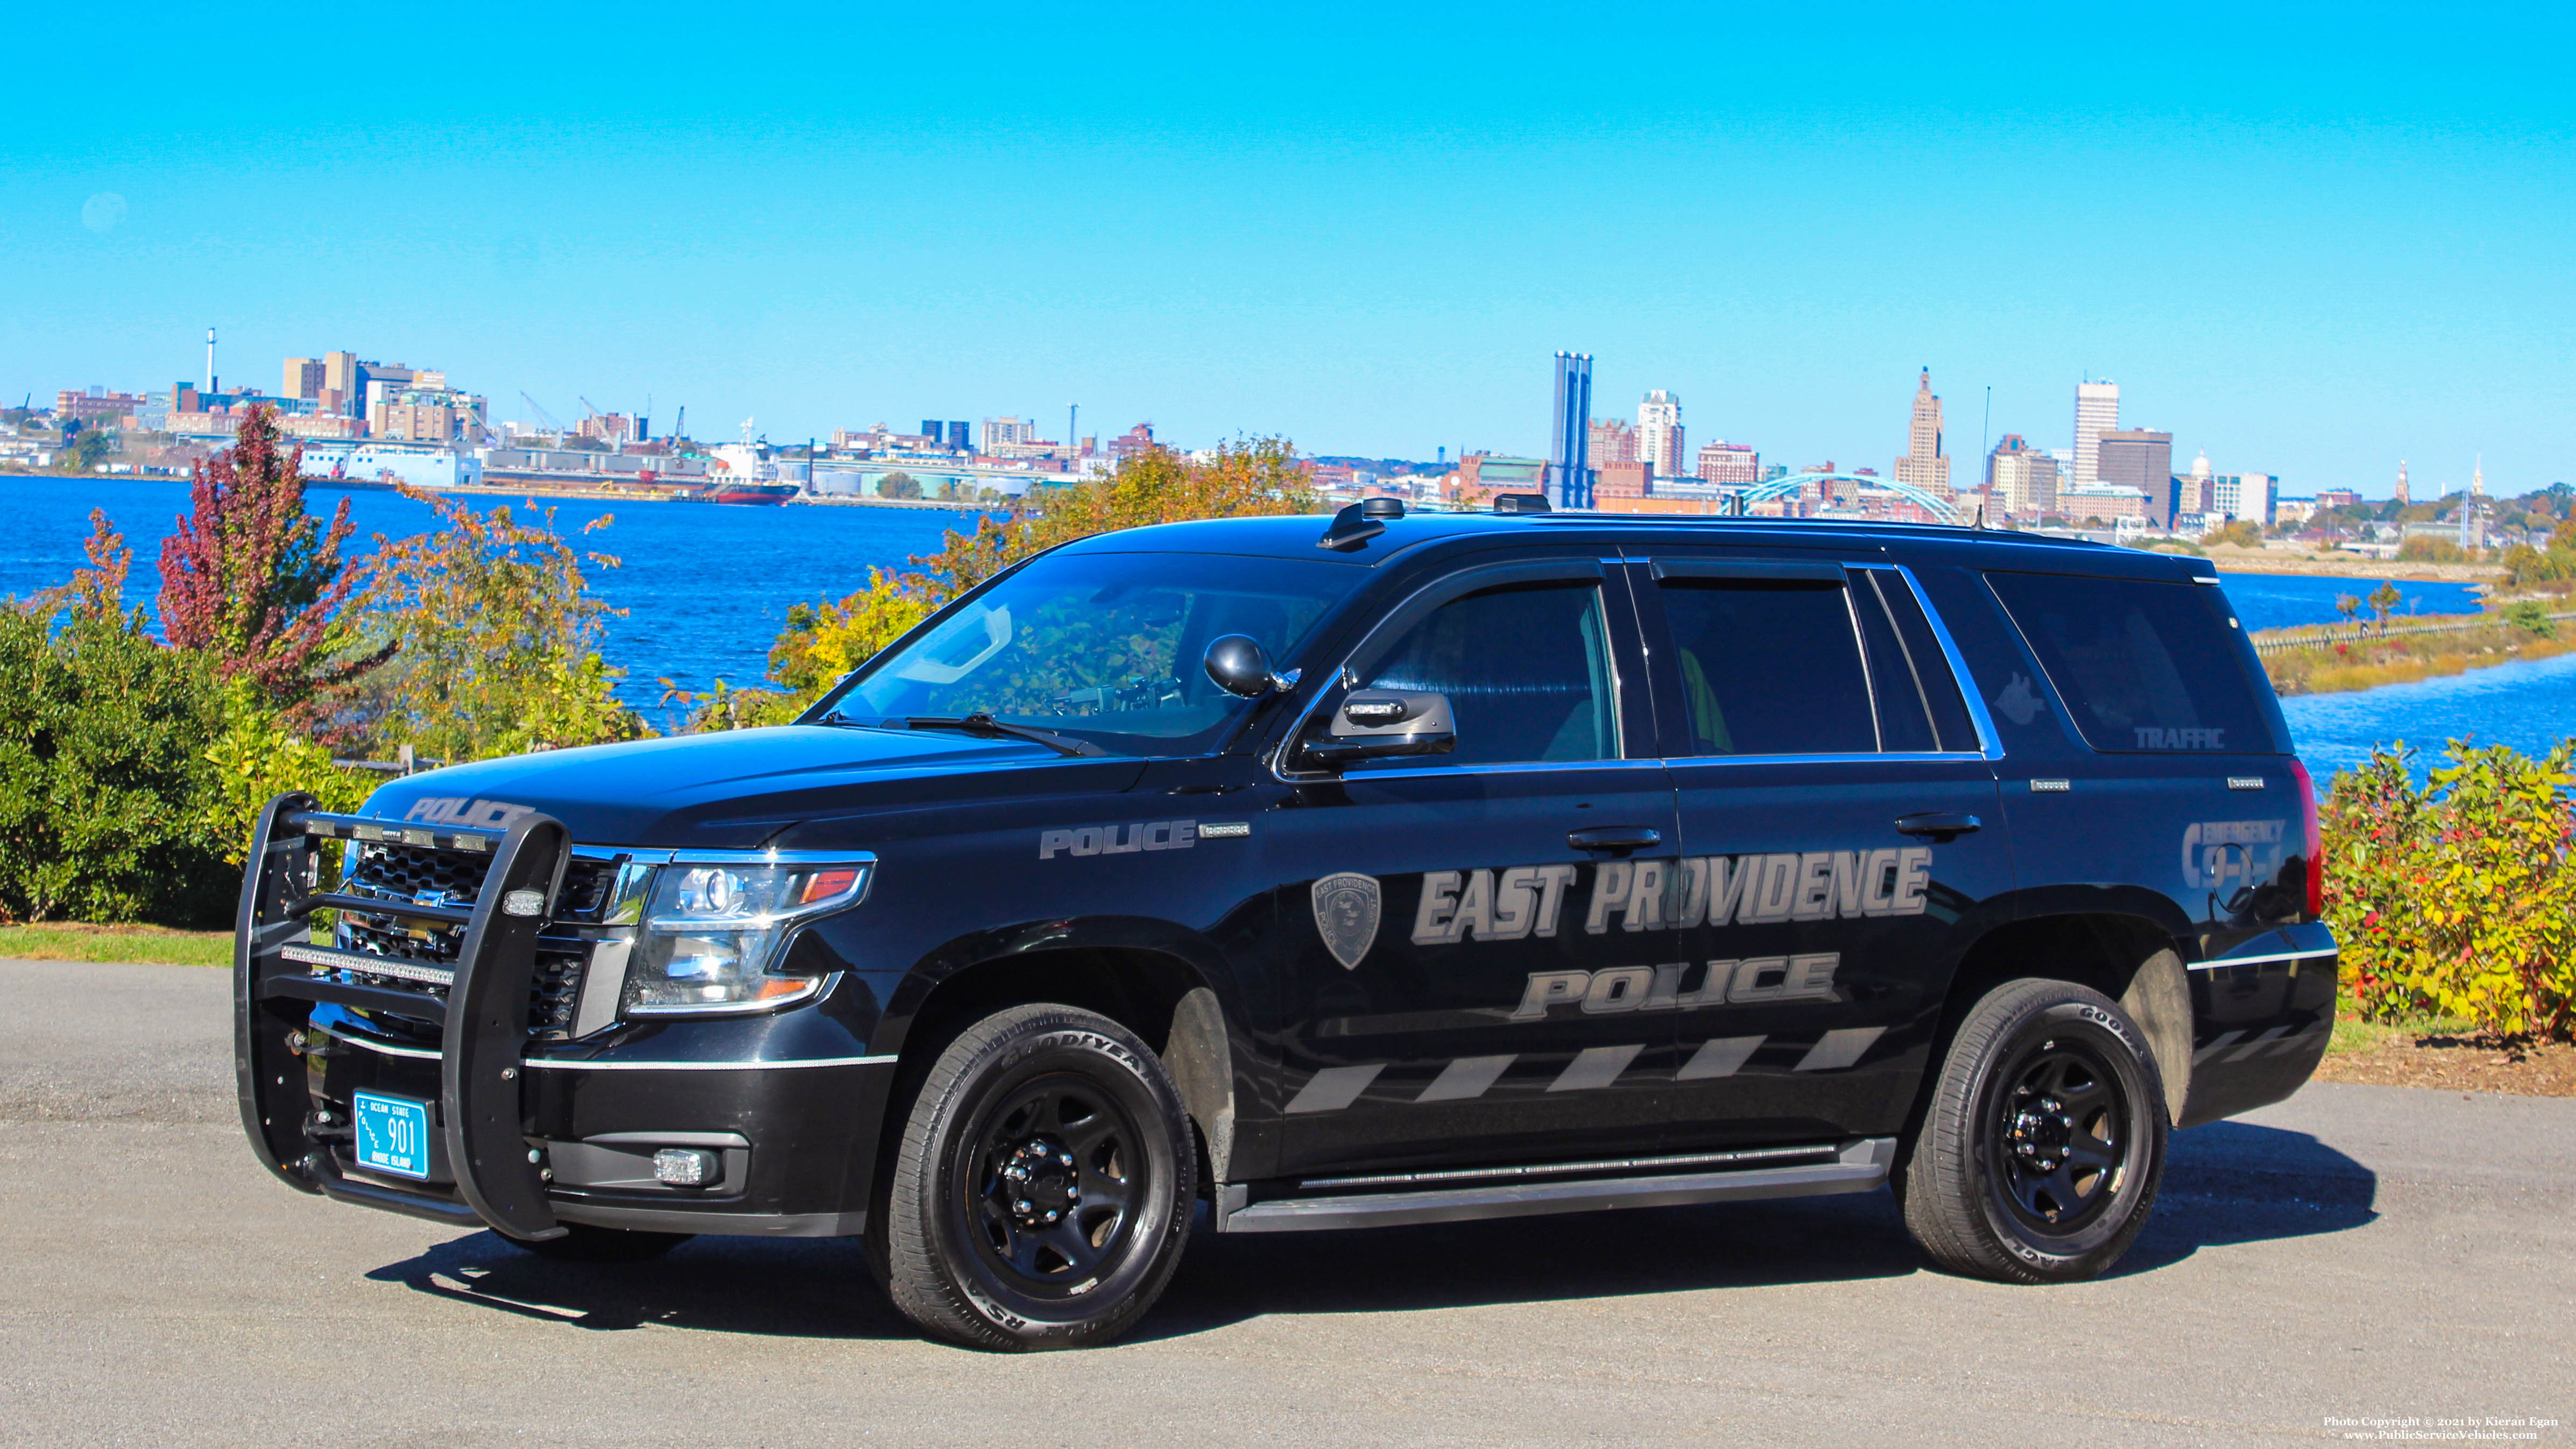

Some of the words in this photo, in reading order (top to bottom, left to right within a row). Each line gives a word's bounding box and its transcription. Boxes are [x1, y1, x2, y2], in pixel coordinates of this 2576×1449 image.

[2134, 727, 2225, 748] TRAFFIC
[404, 797, 536, 829] POLICE
[1039, 819, 1196, 860] POLICE
[1316, 882, 1331, 898] EAST
[1333, 878, 1376, 895] PROVIDENCE
[1409, 864, 1577, 946] EAST
[1584, 845, 1932, 935] PROVIDENCE
[1318, 911, 1337, 948] POLICE
[1509, 952, 1840, 1019] POLICE
[370, 1102, 389, 1114] OCEAN
[392, 1106, 409, 1118] STATE
[358, 1111, 379, 1148] POLICE
[388, 1118, 414, 1155] 901
[371, 1150, 389, 1164] RHODE
[391, 1155, 411, 1169] ISLAND
